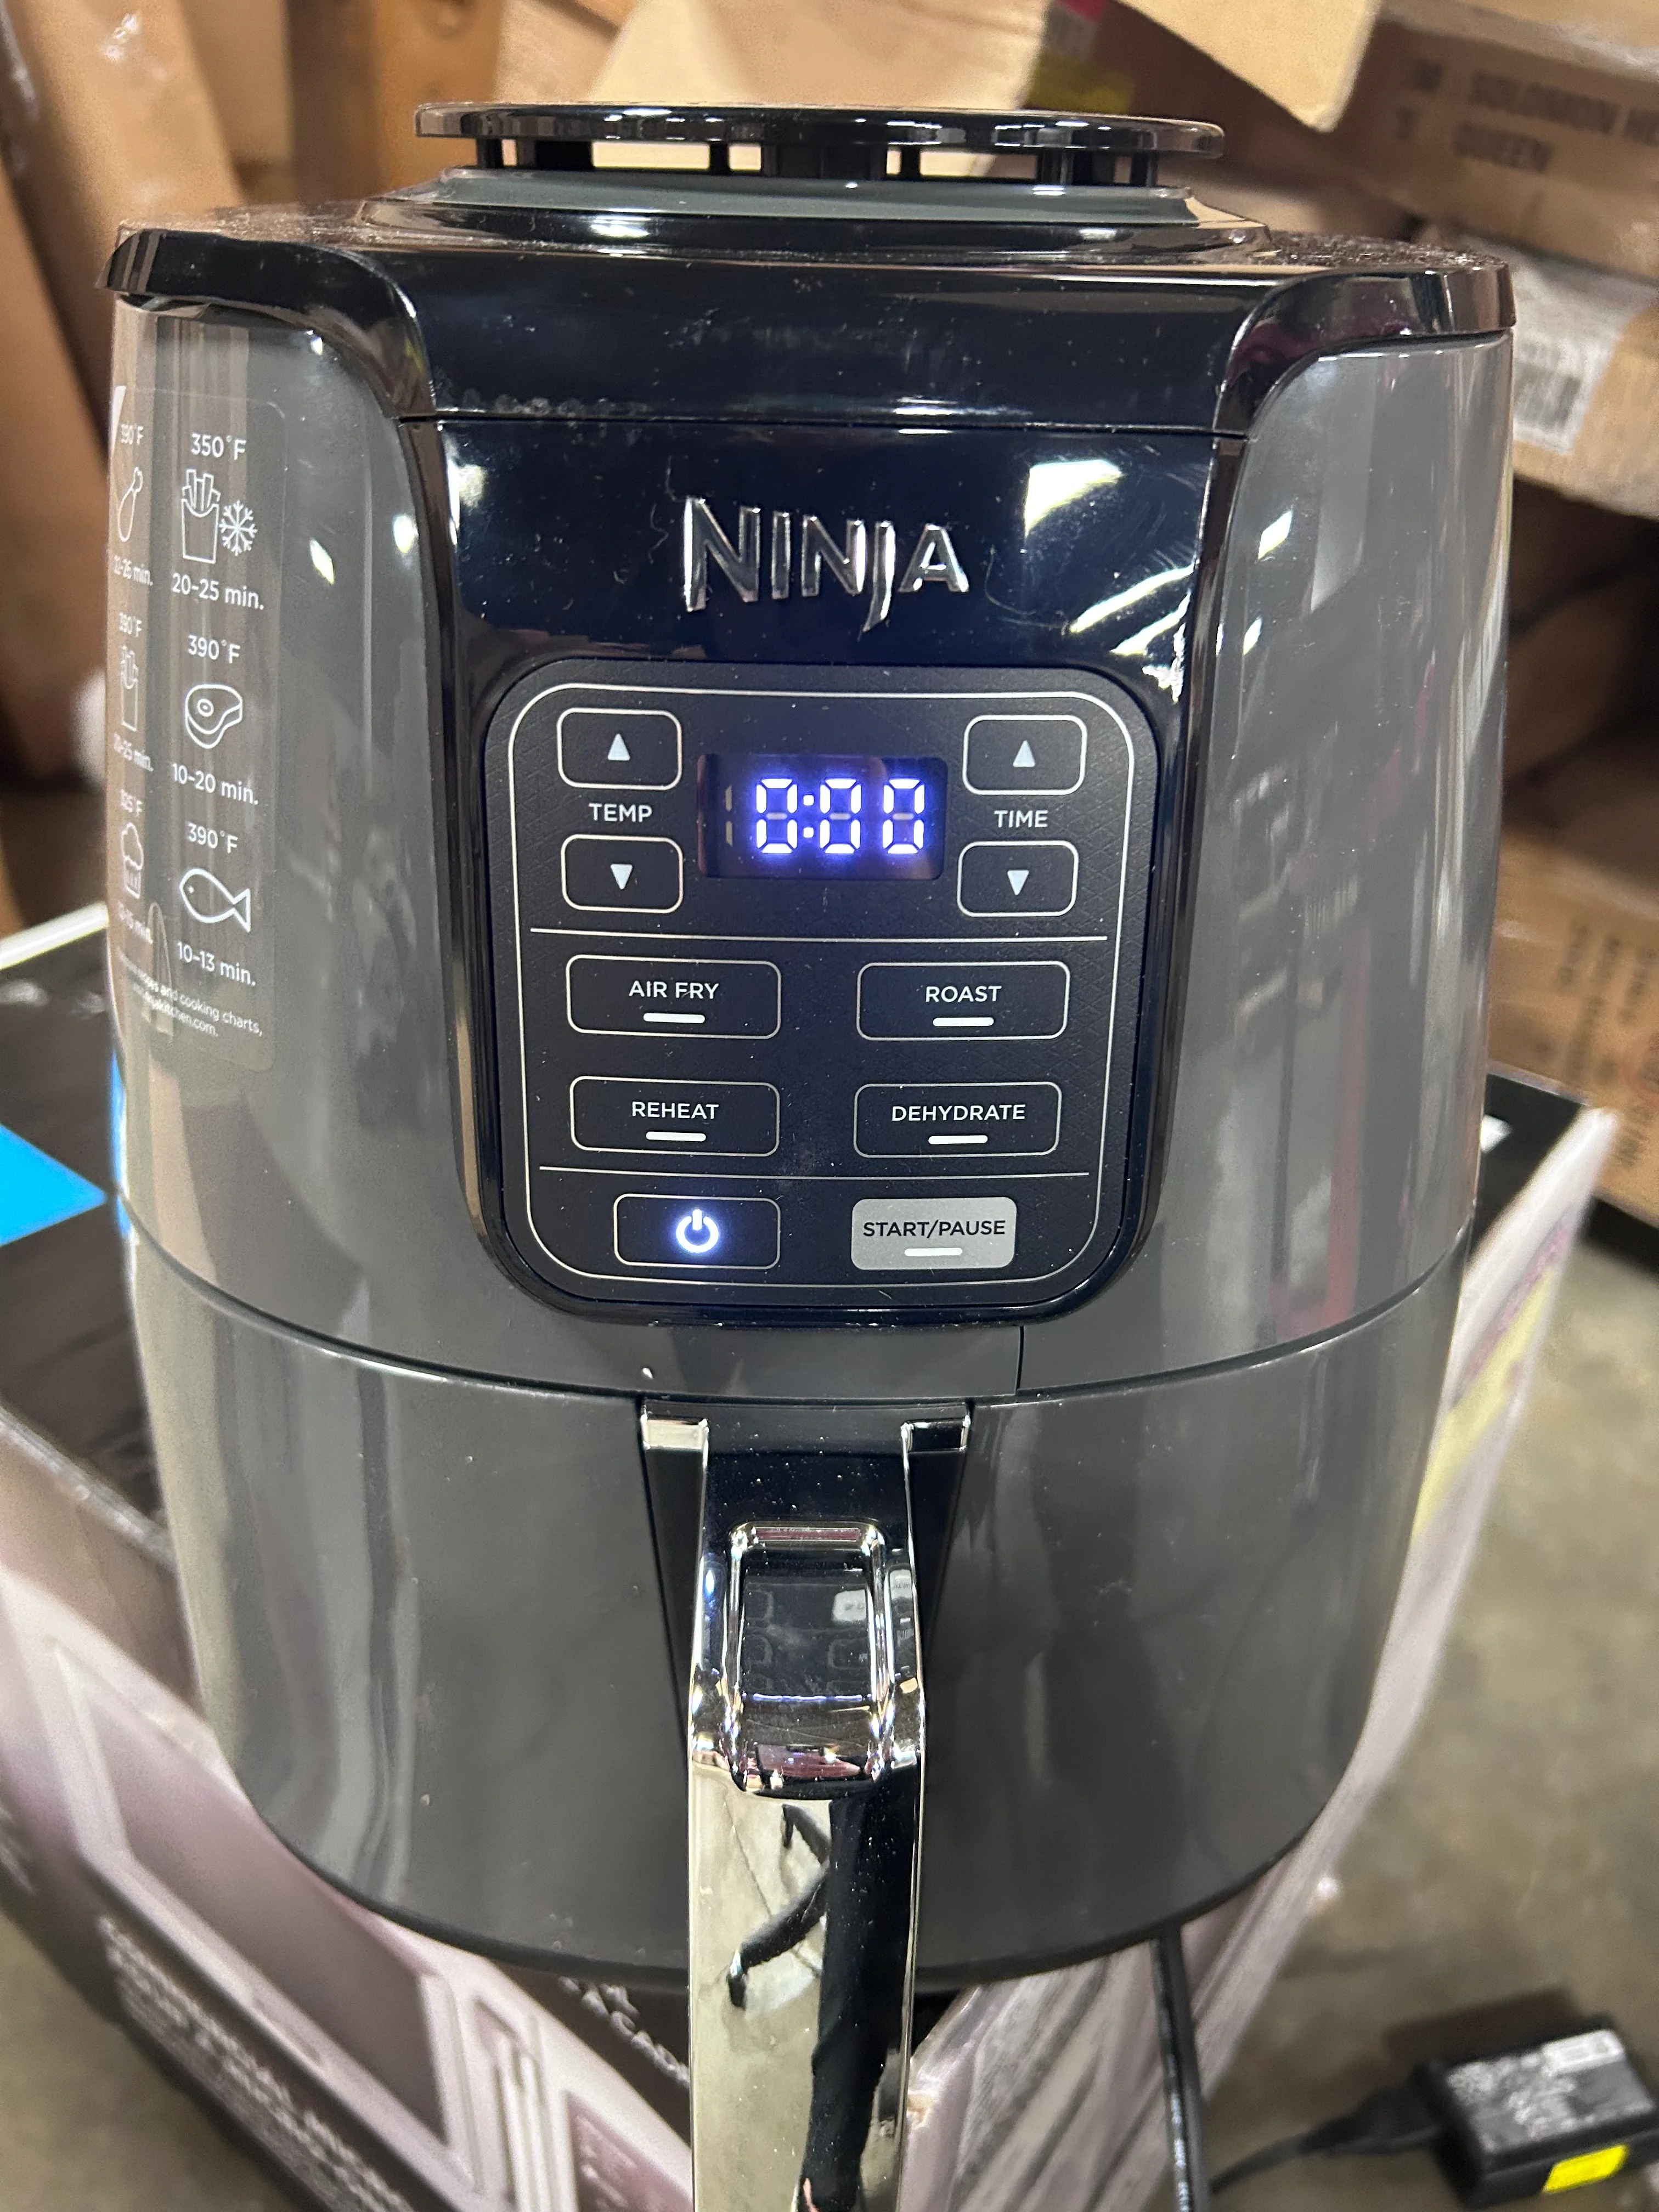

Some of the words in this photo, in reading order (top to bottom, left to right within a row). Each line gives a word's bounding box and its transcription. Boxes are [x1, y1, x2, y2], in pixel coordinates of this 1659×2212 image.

[191, 432, 246, 460] 350°F
[684, 496, 969, 633] NINJA
[172, 573, 219, 601] 20-25
[225, 585, 264, 611] min.
[188, 634, 240, 664] 390°F
[172, 763, 216, 793] 10-20
[221, 781, 258, 805] min.
[588, 803, 653, 823] TEMP
[755, 777, 926, 855] 0:00
[994, 809, 1048, 828] TIME
[186, 822, 238, 854] 390°F
[177, 941, 216, 972] 10-13
[220, 962, 256, 987] min.
[628, 980, 668, 998] AIR
[675, 981, 719, 1000] FRY
[925, 985, 1002, 1003] ROAST
[179, 994, 219, 1023] cooking
[222, 1009, 263, 1037] charts,
[631, 1101, 720, 1120] REHEAT
[891, 1104, 1026, 1121] DEHYDRATE
[862, 1219, 1006, 1239] START/PAUSE
